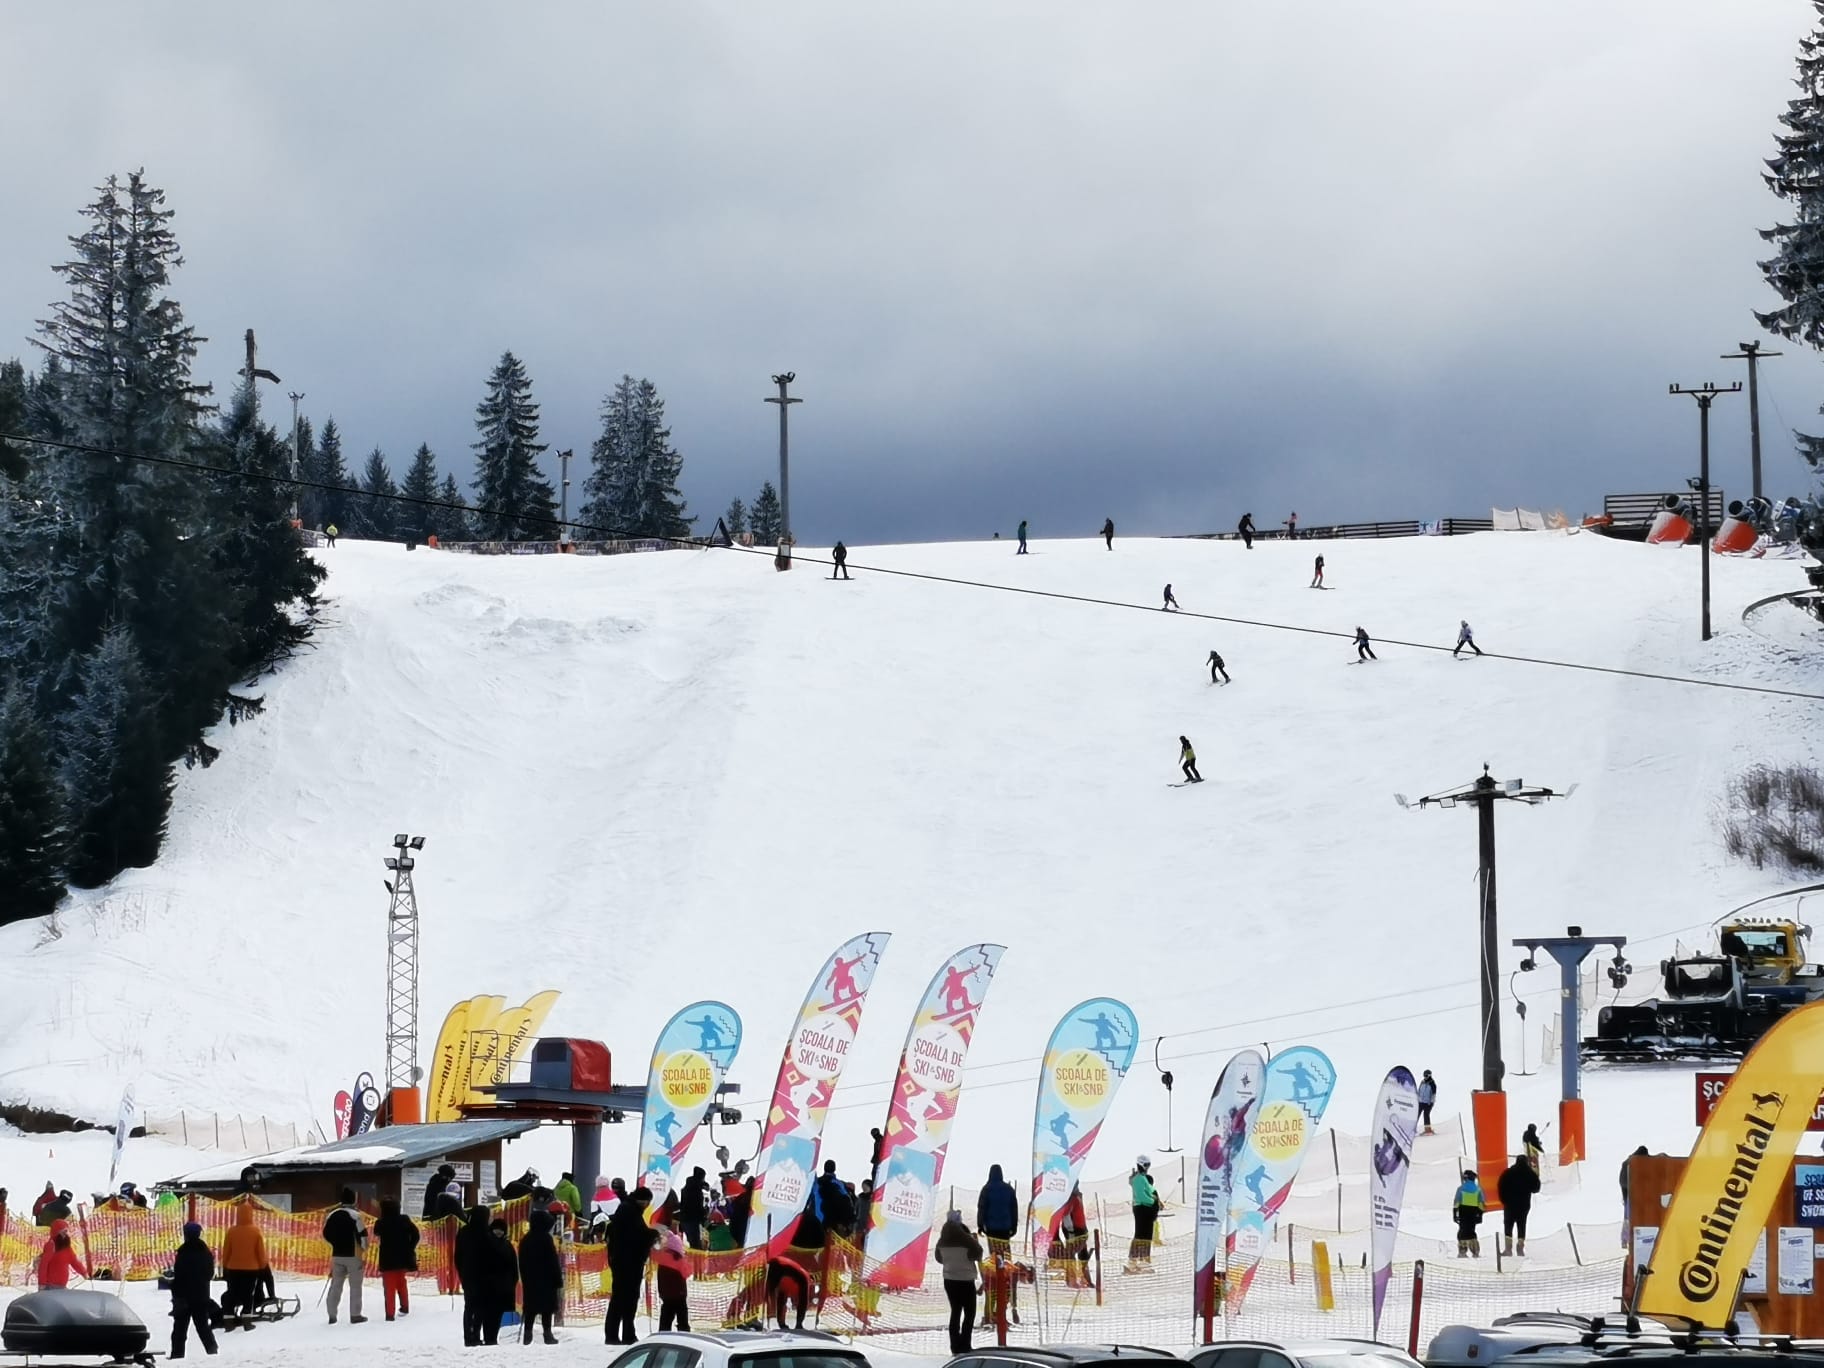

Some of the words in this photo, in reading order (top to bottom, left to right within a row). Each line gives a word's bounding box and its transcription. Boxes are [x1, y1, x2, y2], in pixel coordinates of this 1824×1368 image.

[836, 1039, 850, 1056] DE
[950, 1051, 964, 1068] DE
[699, 1067, 712, 1081] DE
[1094, 1068, 1108, 1081] DE
[1291, 1118, 1304, 1132] DE
[1679, 1113, 1777, 1303] Continental
